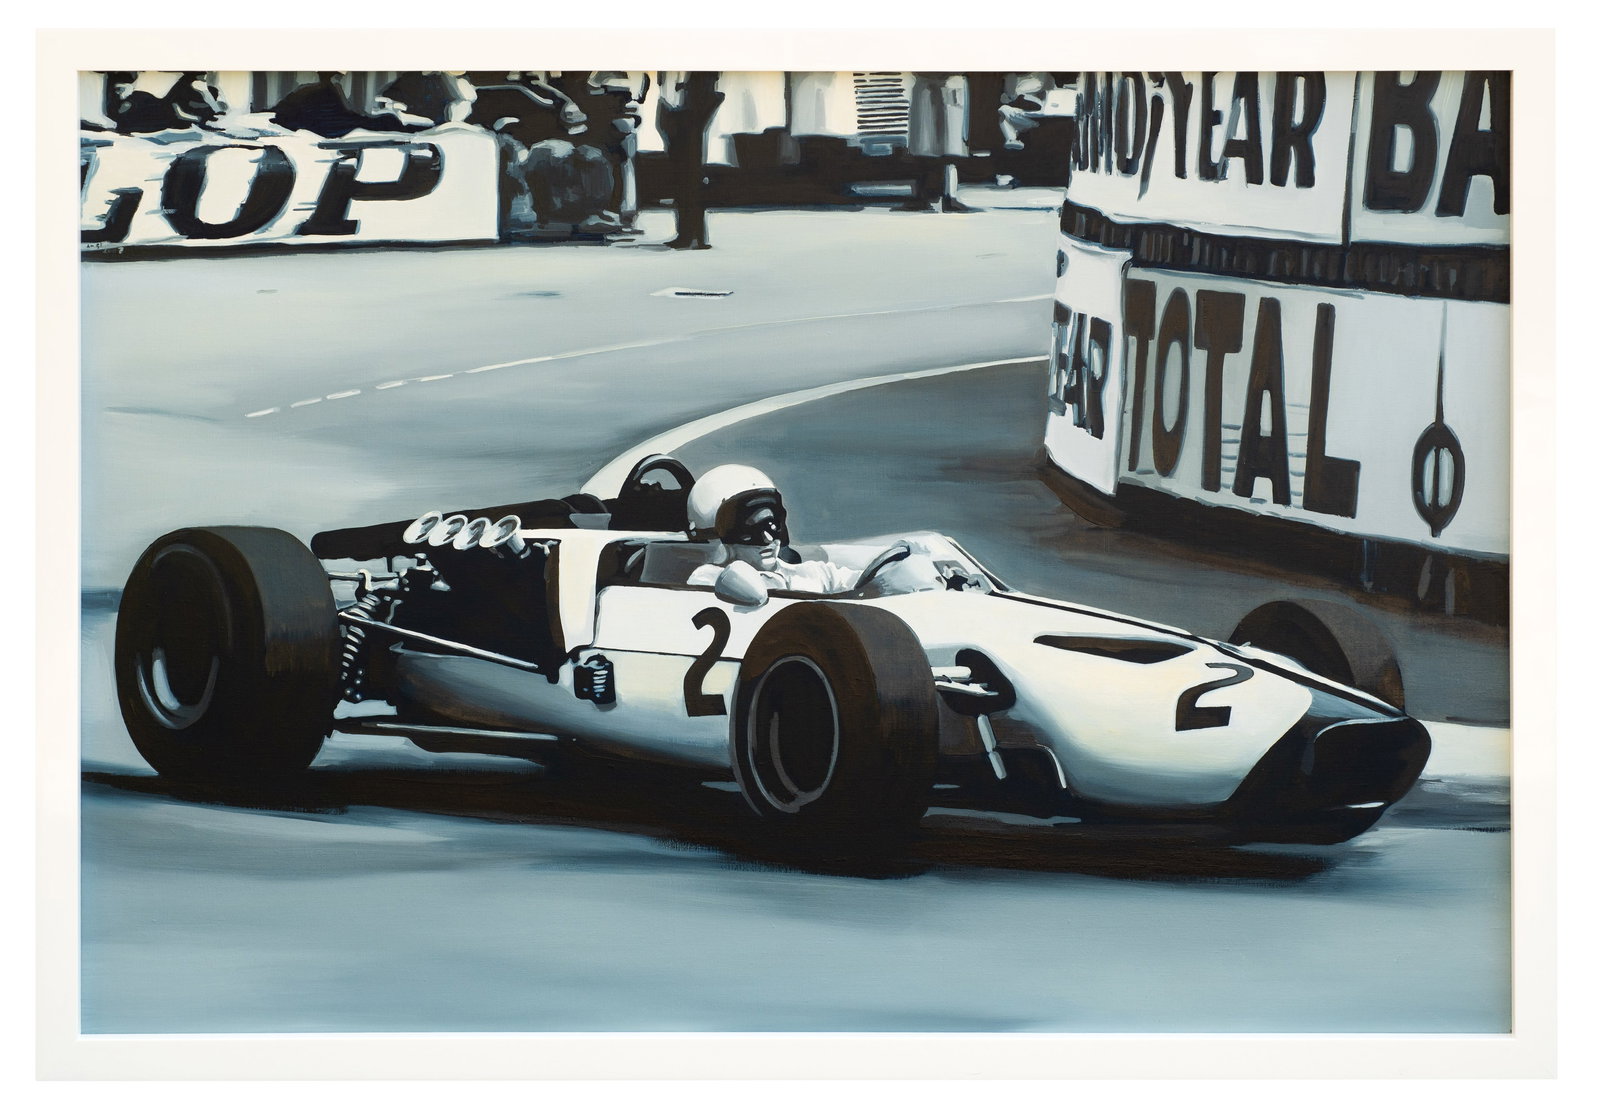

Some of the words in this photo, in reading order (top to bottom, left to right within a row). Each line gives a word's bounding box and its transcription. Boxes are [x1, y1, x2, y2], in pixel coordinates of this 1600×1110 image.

[1124, 279, 1361, 519] TOTAL
[684, 607, 731, 717] 2
[1175, 662, 1255, 731] 2
